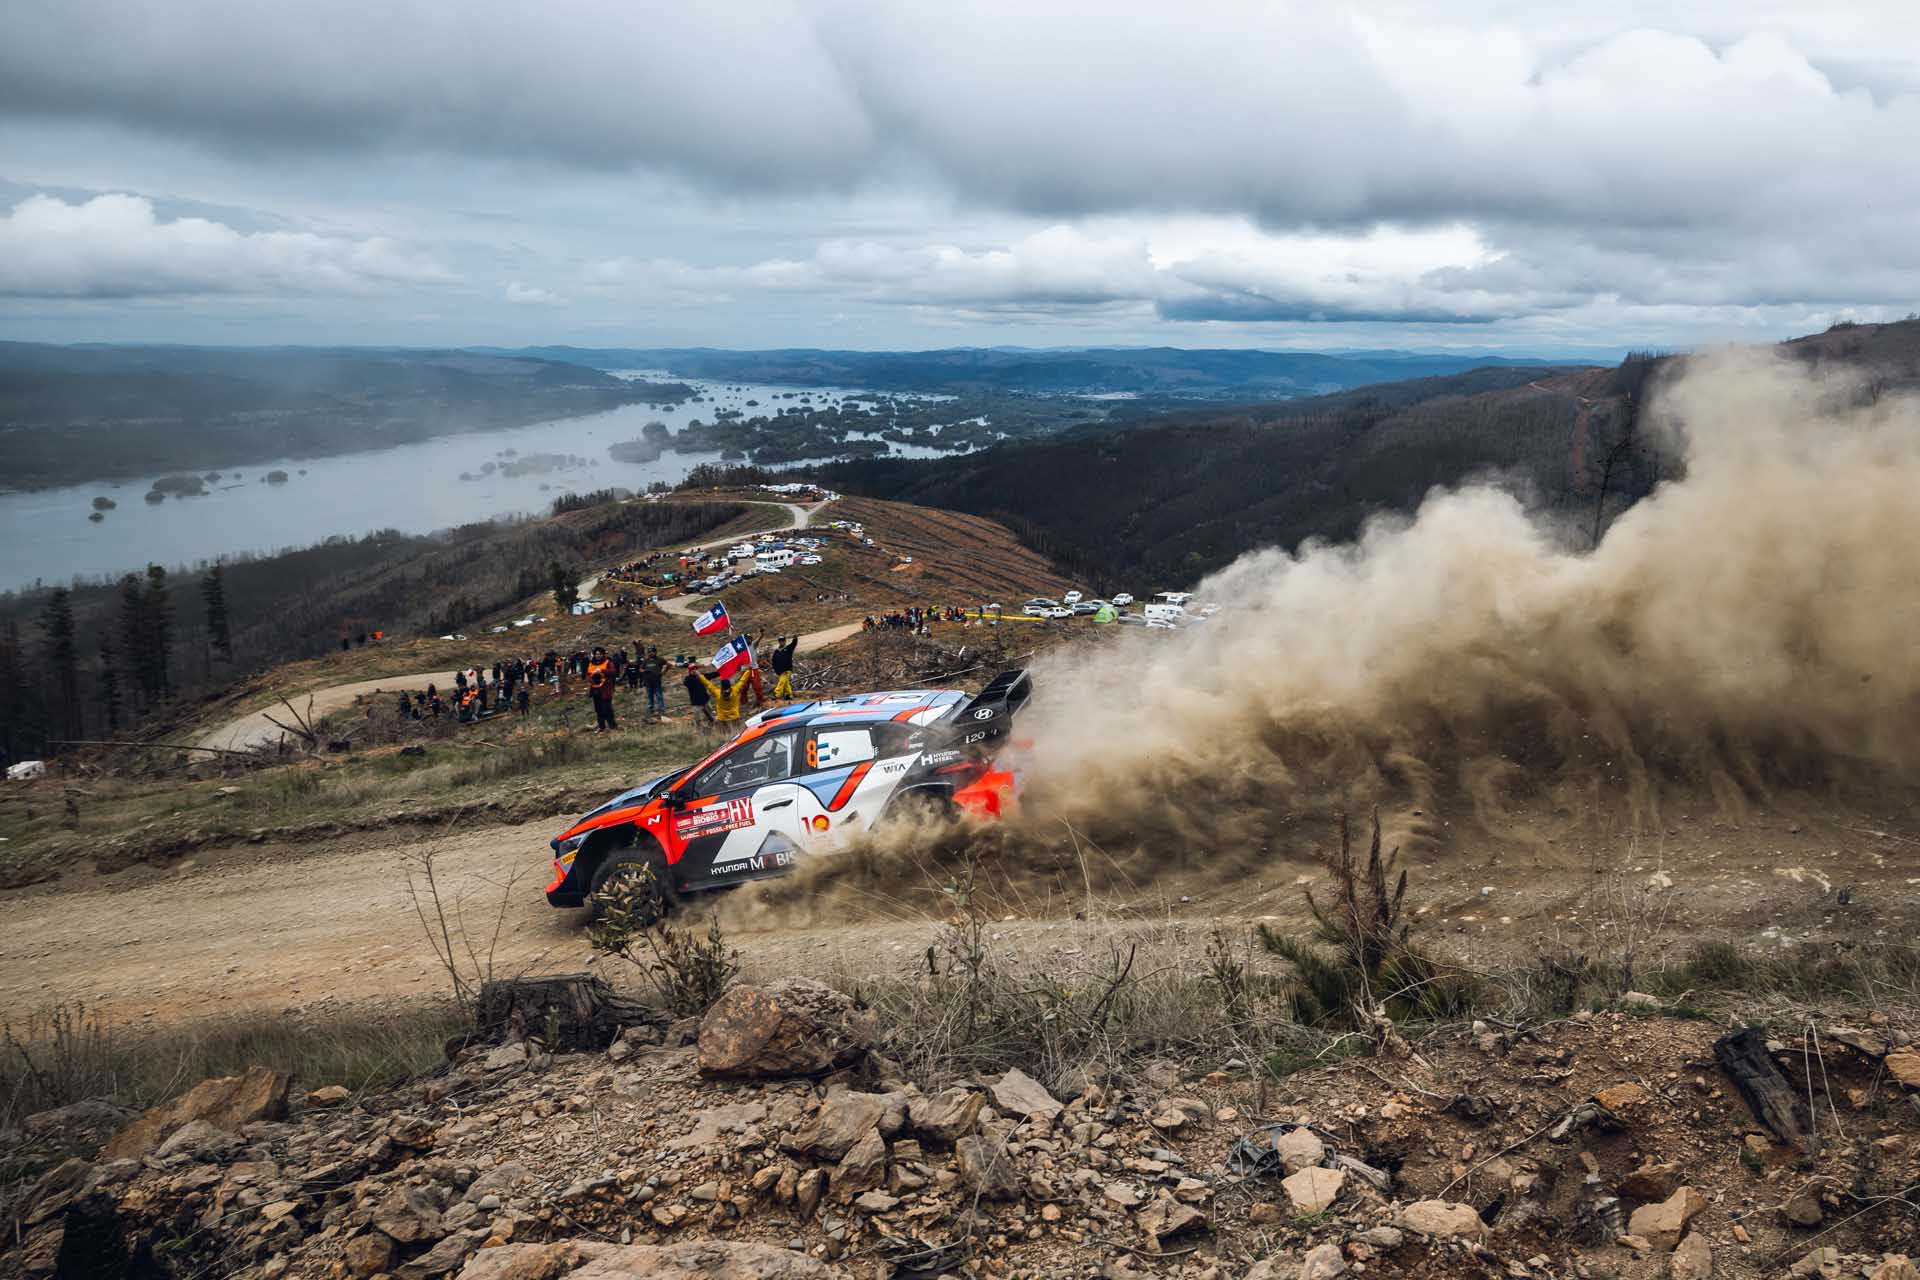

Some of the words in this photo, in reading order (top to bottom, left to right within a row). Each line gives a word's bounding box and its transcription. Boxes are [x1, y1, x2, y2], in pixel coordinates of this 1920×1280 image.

[806, 739, 817, 767] 8
[883, 763, 906, 774] WIA
[728, 797, 750, 821] HY
[711, 862, 748, 876] HYUNDAI
